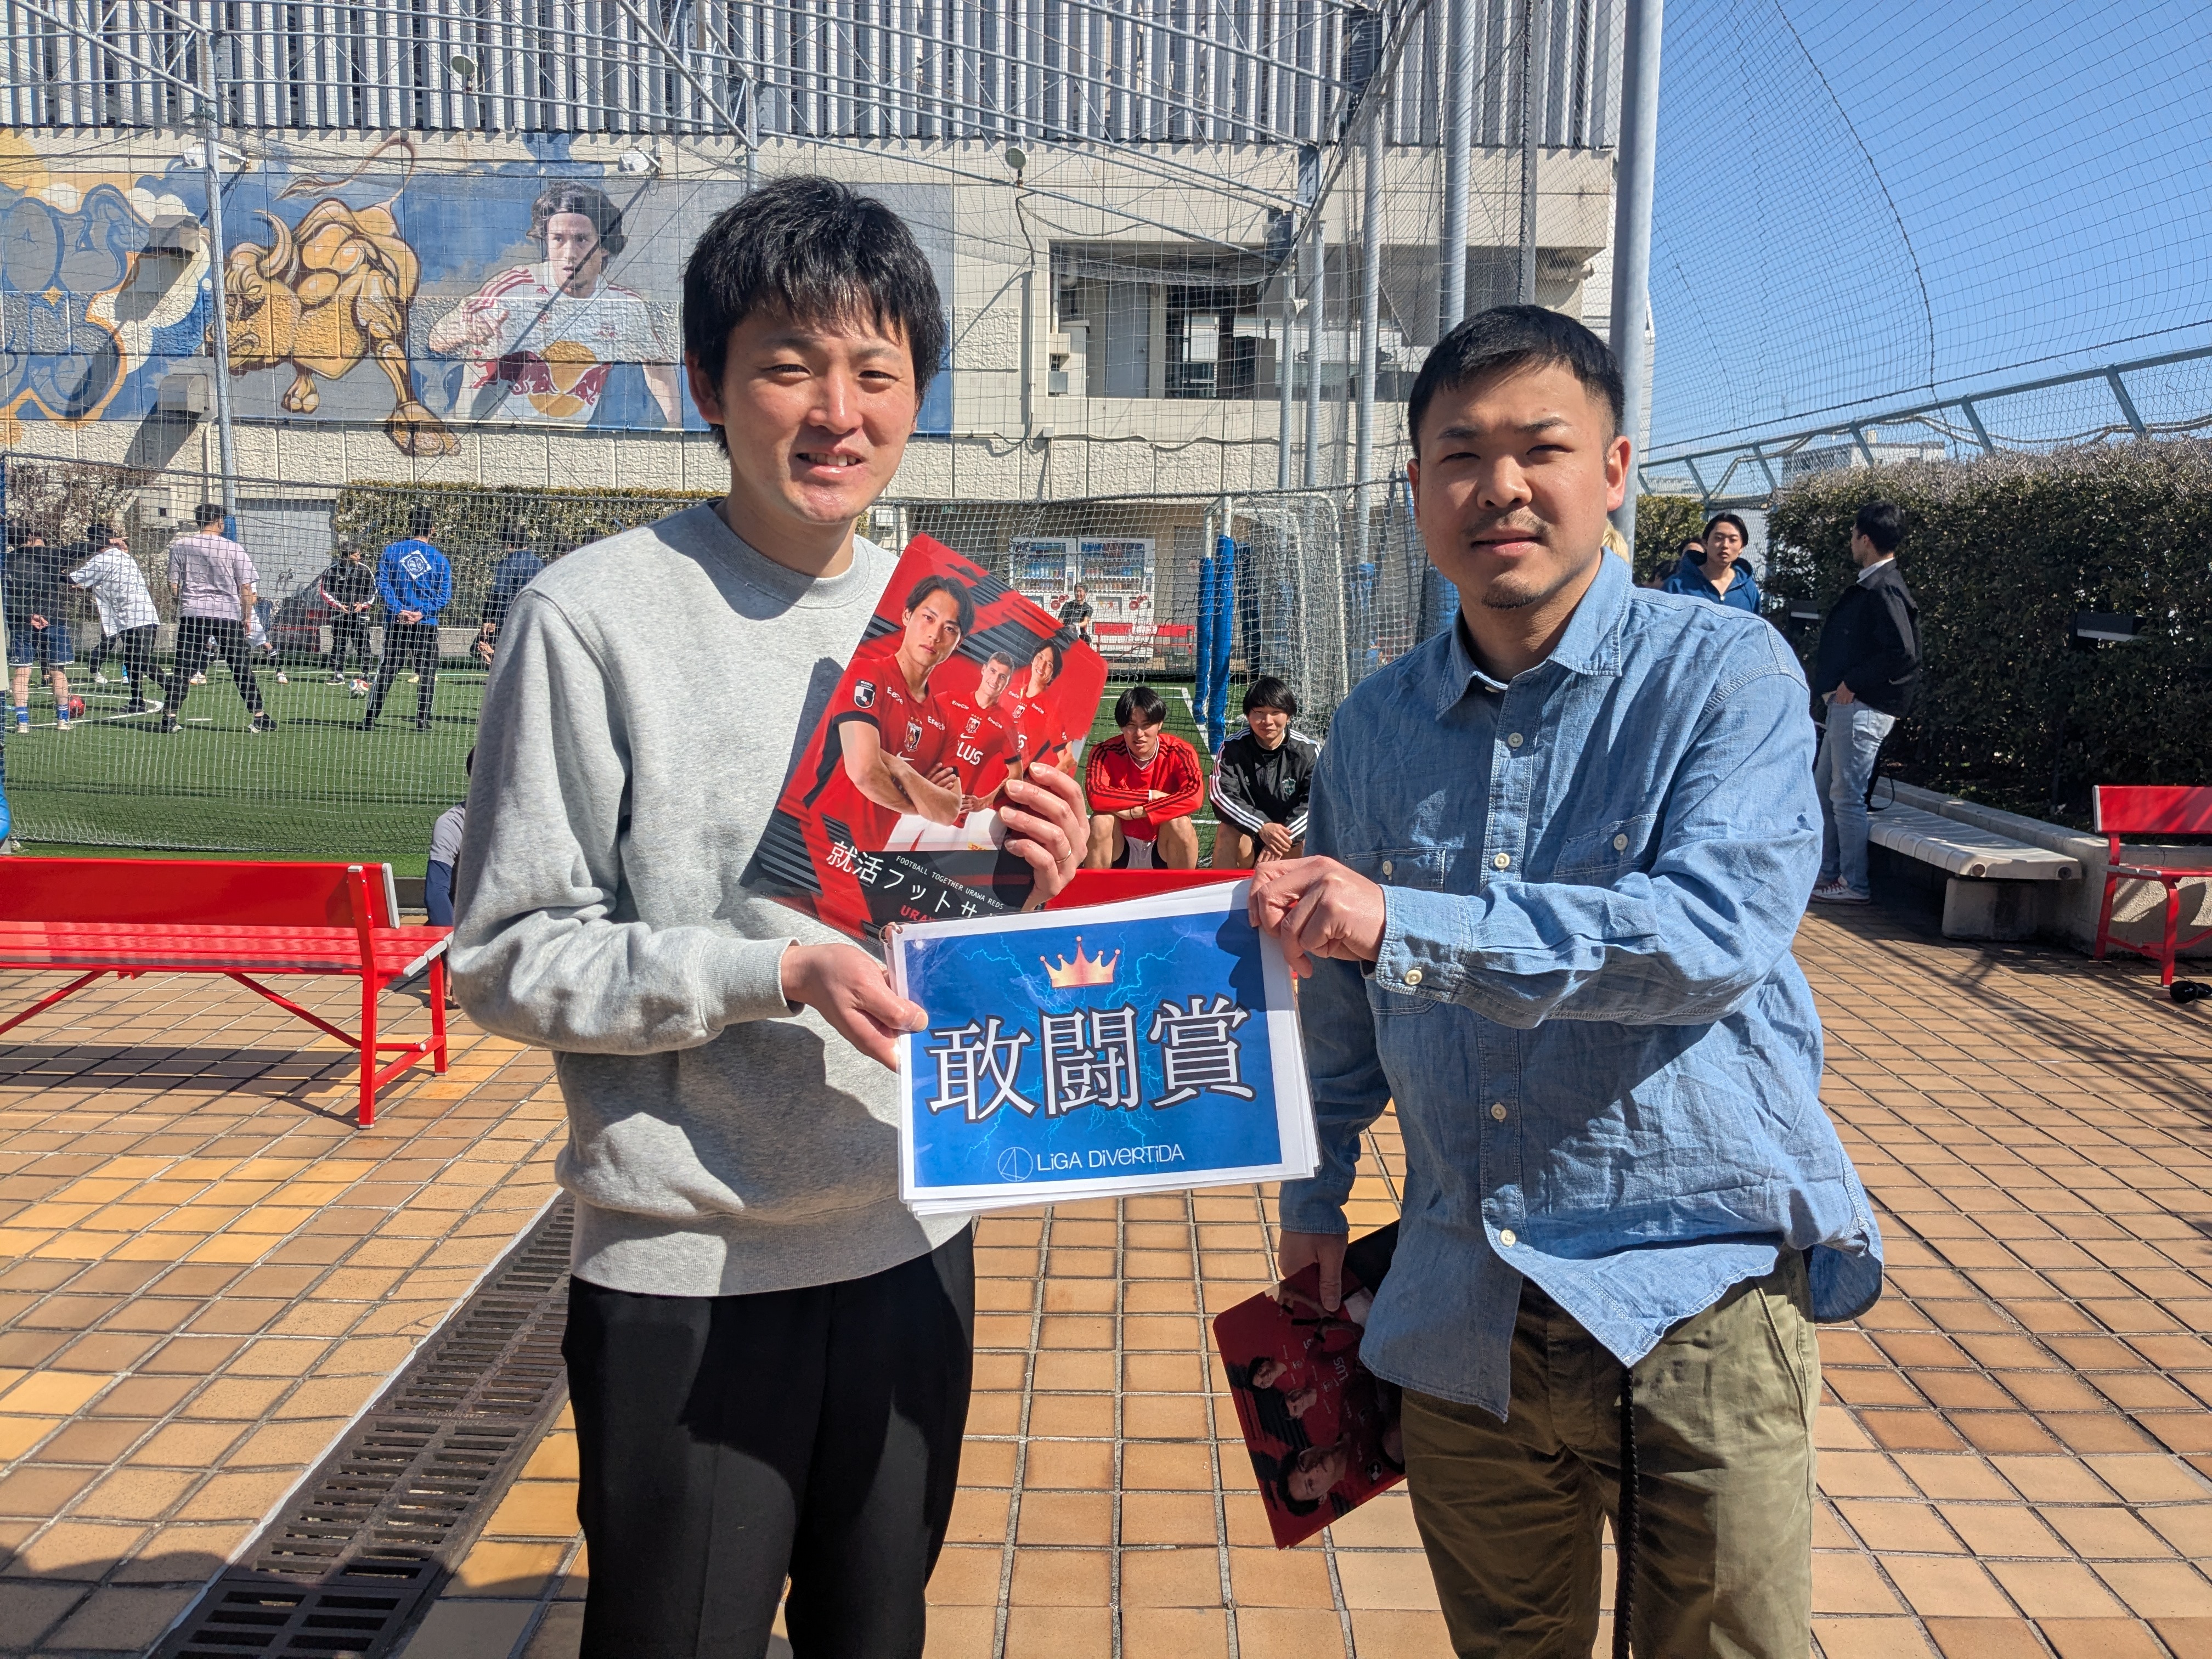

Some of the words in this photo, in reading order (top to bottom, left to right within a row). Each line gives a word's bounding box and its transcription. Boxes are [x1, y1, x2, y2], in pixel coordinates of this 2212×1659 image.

[956, 741, 984, 765] LUS
[826, 840, 995, 918] 就活フットサ
[896, 855, 928, 876] FOOTBALL
[932, 871, 964, 891] TOGETHER
[966, 887, 985, 901] URAWA
[988, 898, 1004, 910] REDS
[900, 905, 935, 921] URA
[927, 995, 1255, 1122] 敢闘賞
